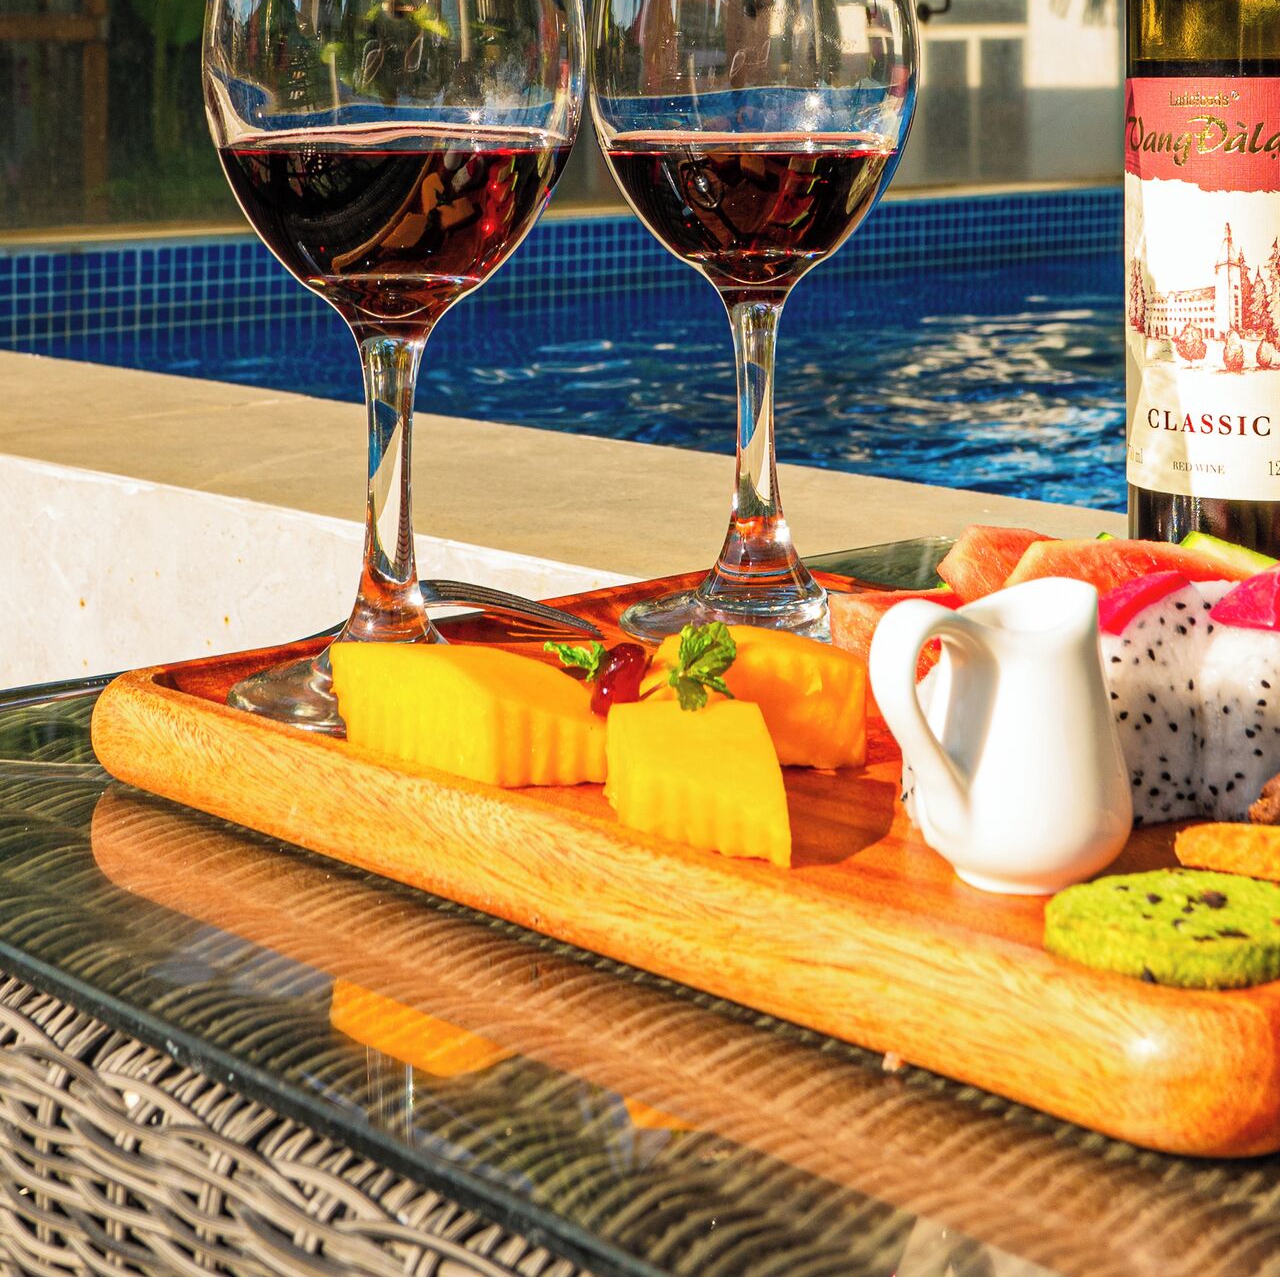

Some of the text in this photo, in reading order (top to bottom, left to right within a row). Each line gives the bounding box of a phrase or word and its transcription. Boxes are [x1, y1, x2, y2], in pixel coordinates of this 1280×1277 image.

[1148, 408, 1271, 436] CLASSIC
[1172, 461, 1226, 475] RED WINE
